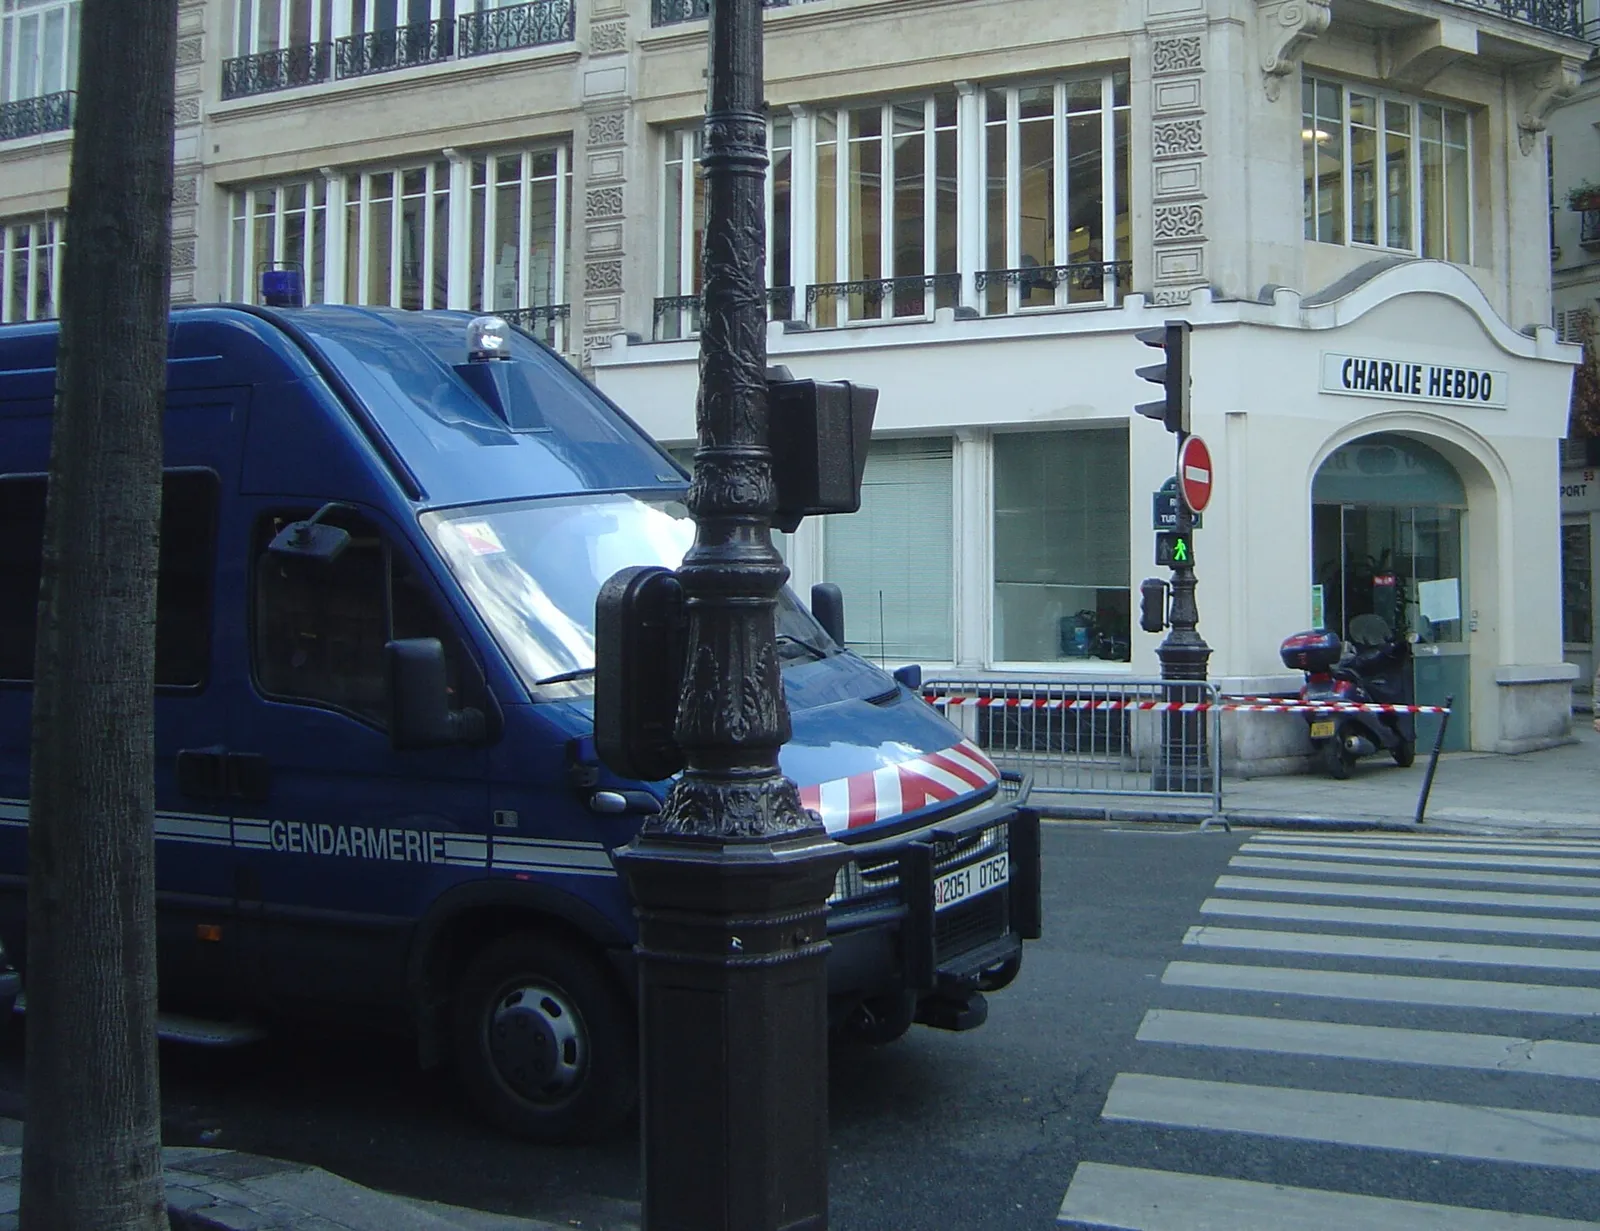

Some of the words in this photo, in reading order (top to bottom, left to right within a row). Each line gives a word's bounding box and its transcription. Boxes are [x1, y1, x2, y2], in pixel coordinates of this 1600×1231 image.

[1342, 358, 1421, 394] CHARLIE
[1428, 366, 1492, 401] HEBDO
[270, 819, 445, 864] GENDARMERIE
[943, 869, 971, 903] 2051
[979, 856, 1007, 888] 0762
